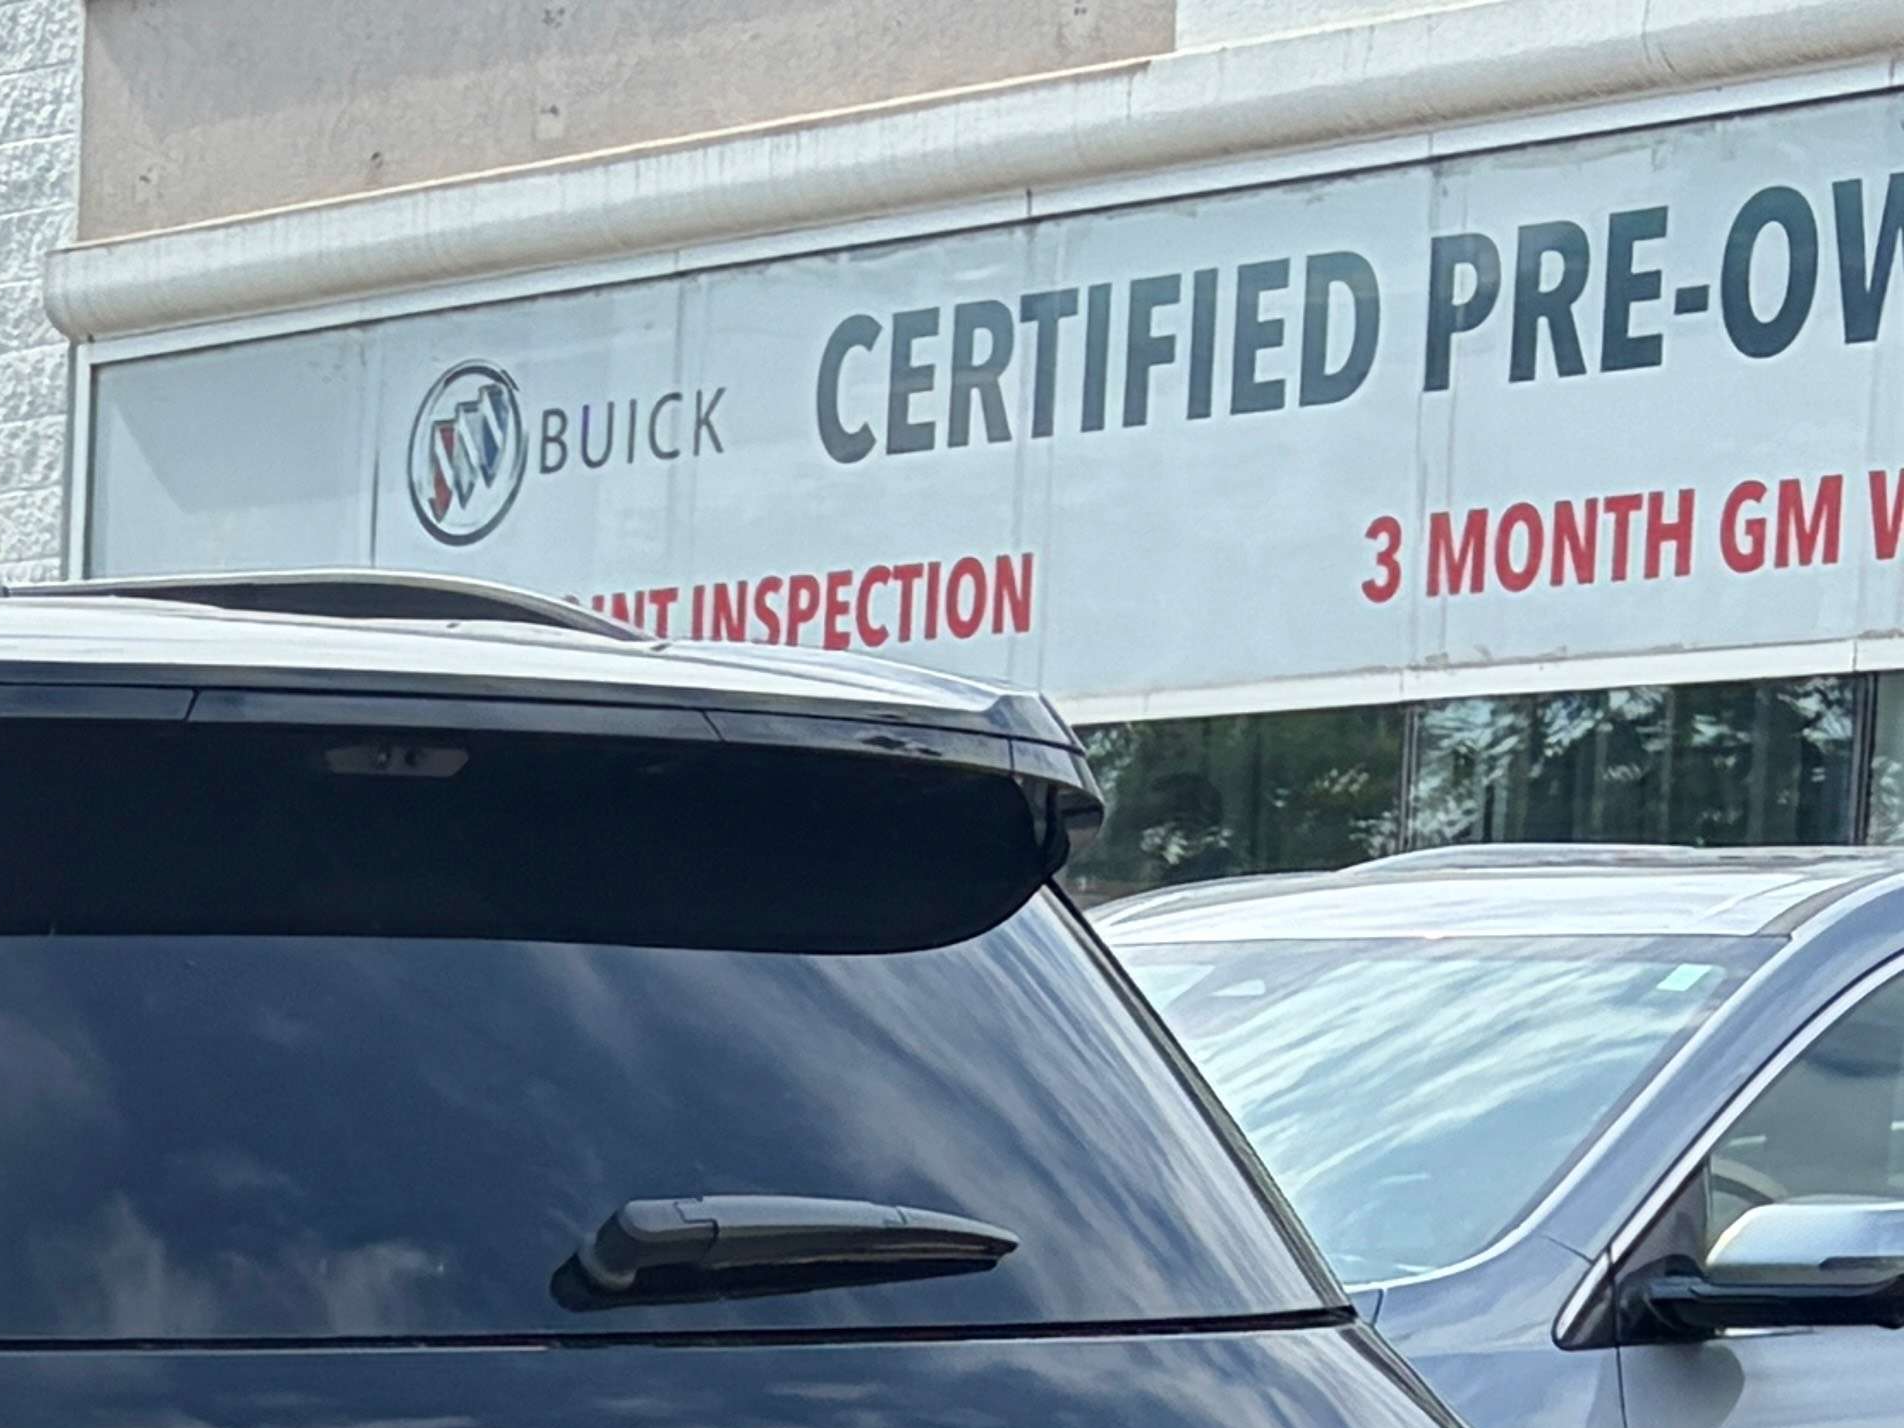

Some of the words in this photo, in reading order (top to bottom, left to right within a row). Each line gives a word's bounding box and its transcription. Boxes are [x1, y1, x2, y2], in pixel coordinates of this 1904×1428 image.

[816, 250, 1381, 464] CERTIFIED
[539, 386, 727, 475] BUICK
[1361, 515, 1402, 603] 3
[1426, 488, 1695, 597] MONTH
[1720, 473, 1844, 574] GM
[692, 552, 1034, 652] INSPECTION
